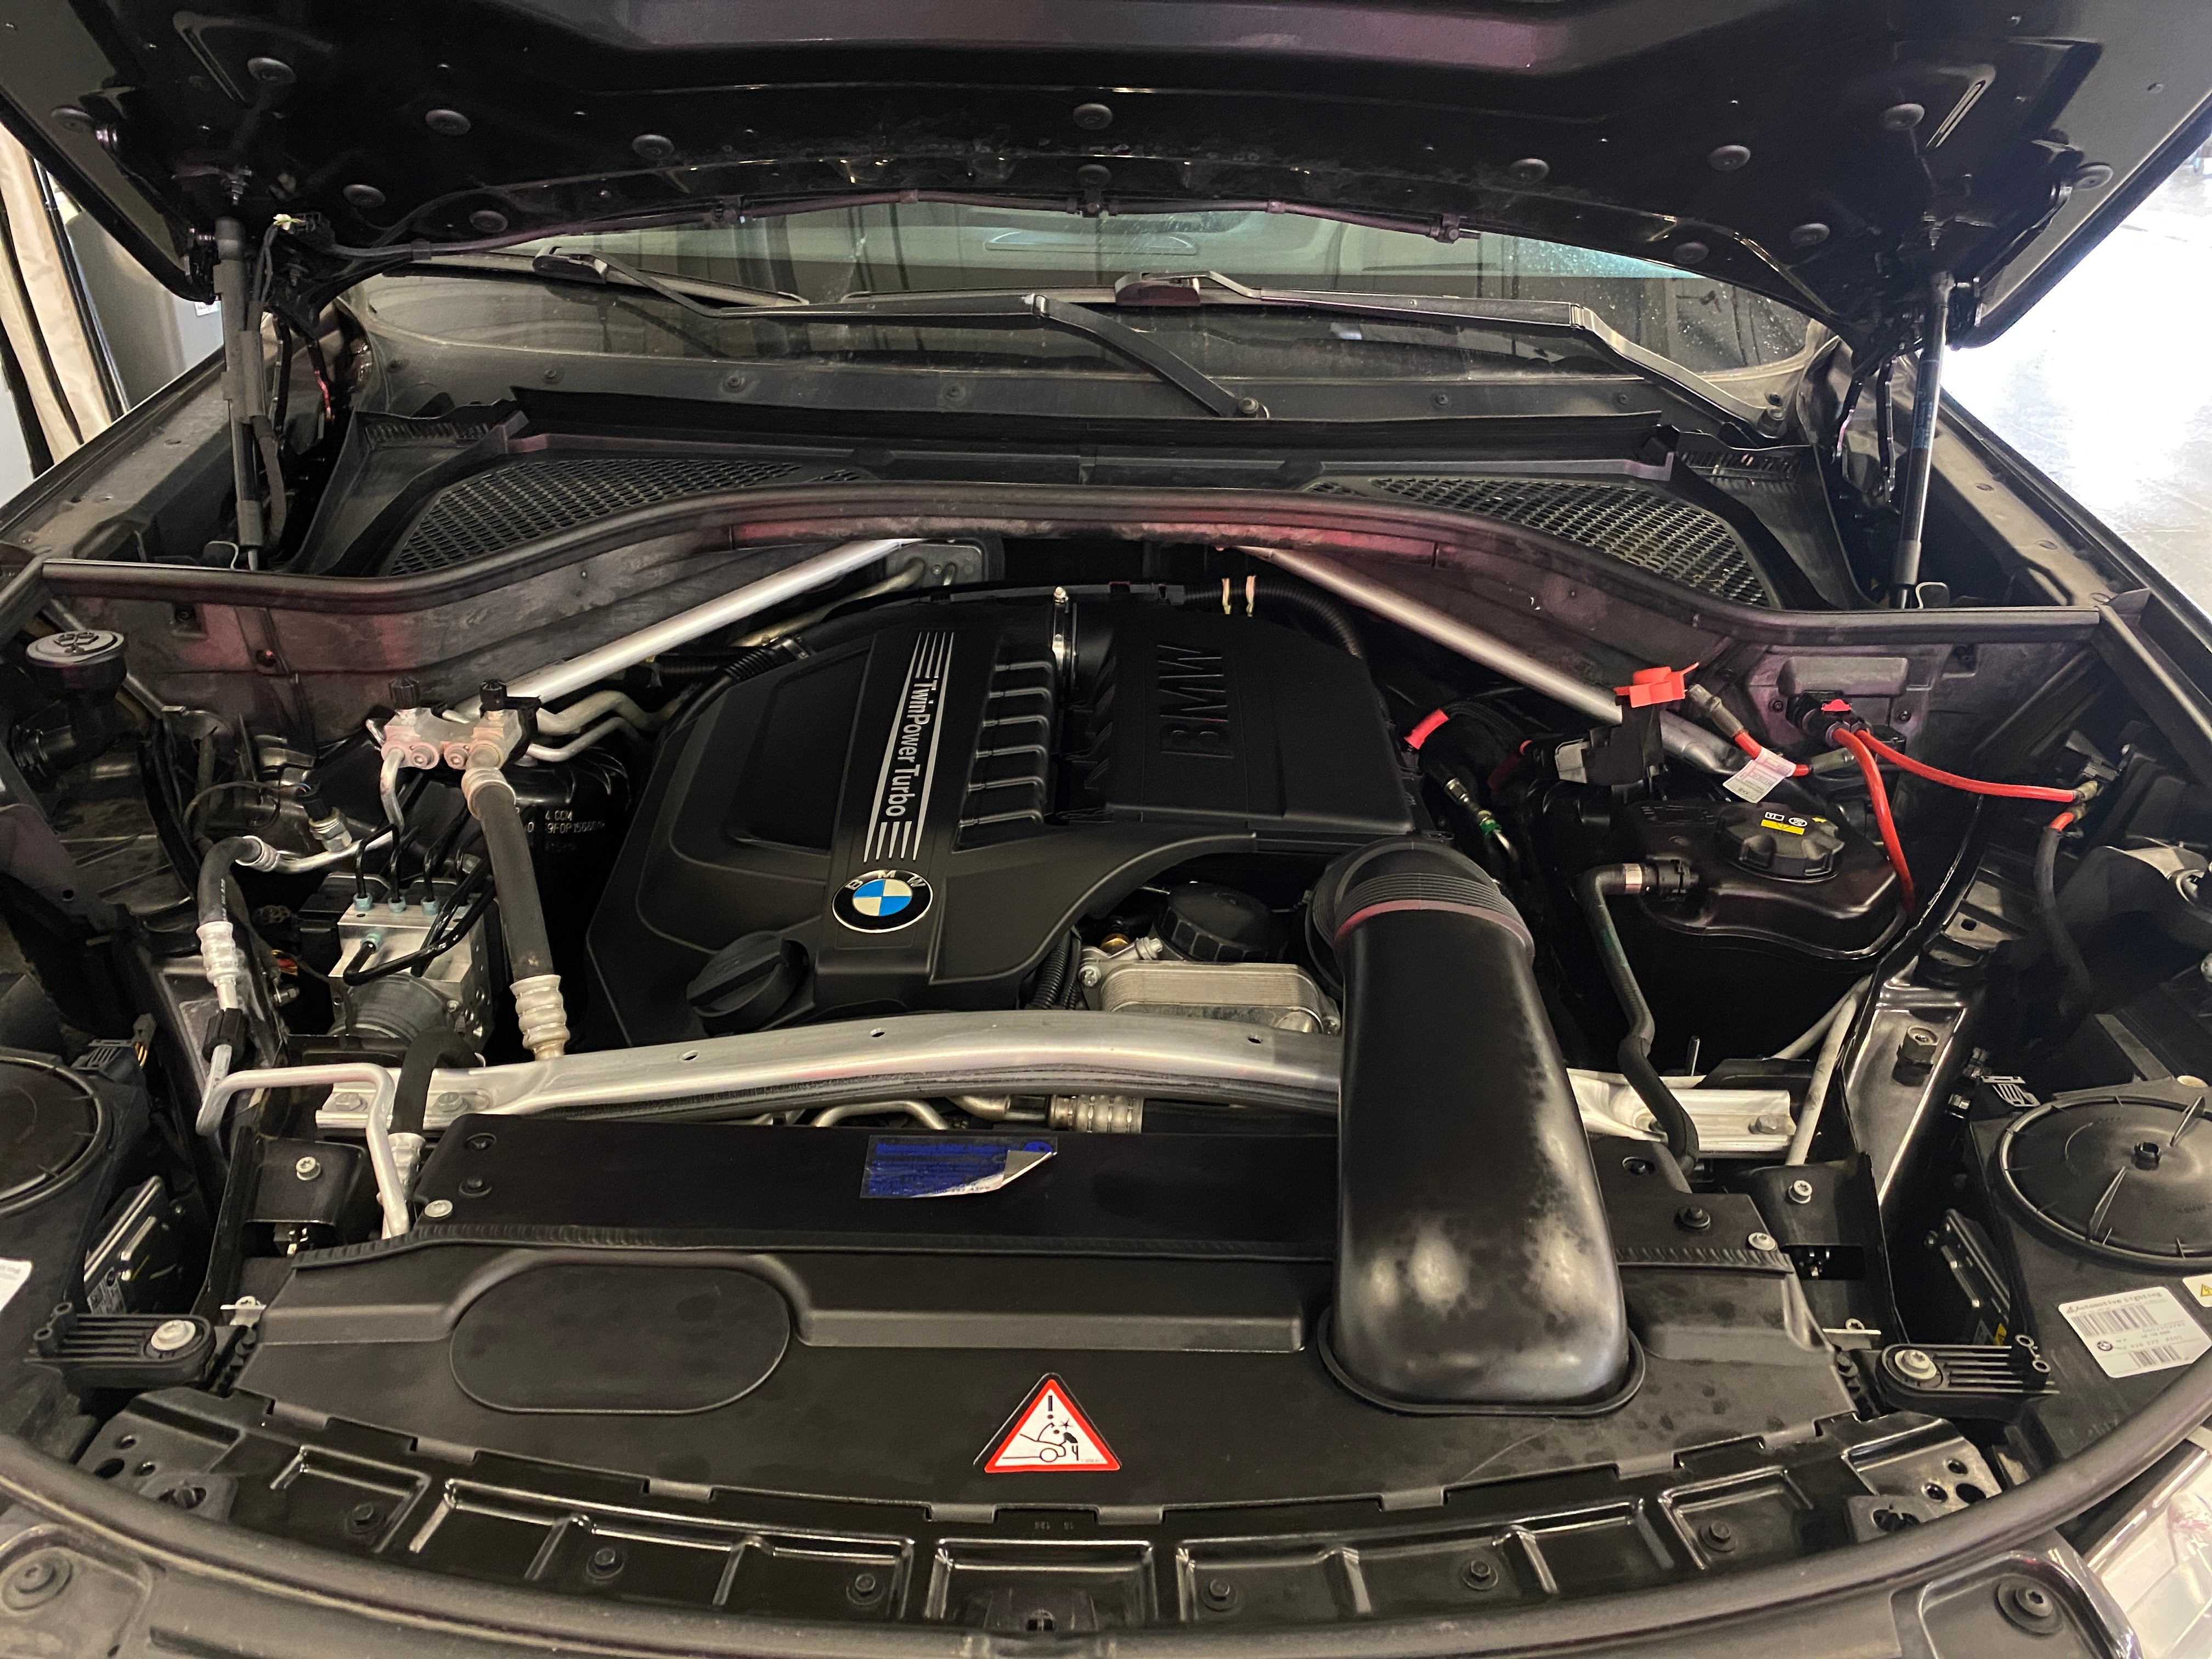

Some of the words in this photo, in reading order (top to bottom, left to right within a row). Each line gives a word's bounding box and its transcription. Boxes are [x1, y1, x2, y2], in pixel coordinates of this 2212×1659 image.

[897, 680, 938, 763] TwinPower
[1157, 644, 1233, 759] BMW
[885, 764, 921, 816] Turbo
[844, 870, 926, 890] BMW
